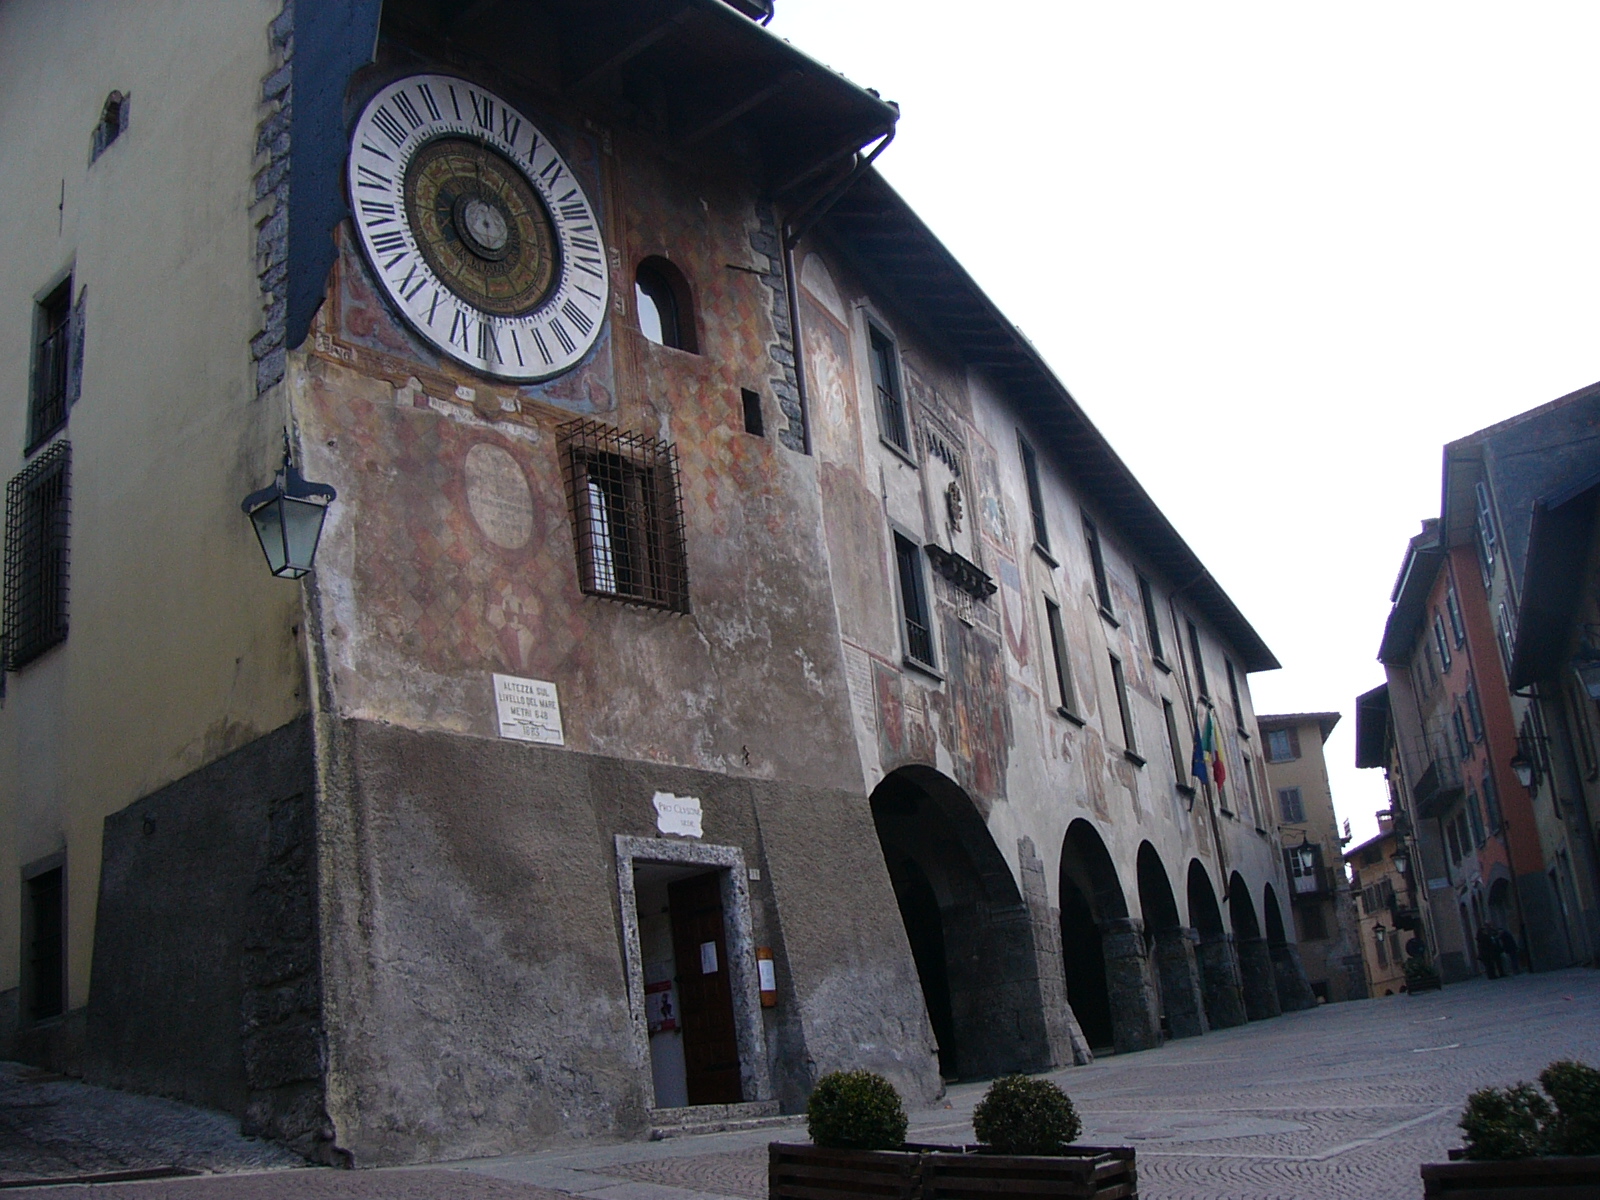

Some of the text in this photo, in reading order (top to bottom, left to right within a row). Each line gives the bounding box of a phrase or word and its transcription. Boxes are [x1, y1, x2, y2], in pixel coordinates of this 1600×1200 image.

[391, 90, 424, 130] III
[418, 84, 442, 121] II
[449, 85, 461, 121] I
[469, 90, 494, 132] XII
[371, 104, 408, 149] IIII
[498, 107, 521, 147] XI
[362, 132, 395, 163] V
[522, 133, 546, 165] X
[358, 165, 392, 192] VI
[539, 157, 569, 190] IX
[360, 199, 396, 228] VII
[557, 188, 590, 221] VIII
[370, 230, 409, 271] VIII
[569, 224, 599, 253] VII
[391, 262, 428, 303] IX
[573, 255, 603, 280] VI
[418, 289, 449, 328] X
[573, 284, 601, 310] V
[448, 308, 475, 354] XI
[548, 317, 577, 356] III
[561, 298, 595, 338] IIII
[477, 321, 504, 365] XII
[511, 328, 525, 367] I
[530, 327, 554, 365] II
[499, 694, 556, 709] LIVELLO DEL MARE
[504, 682, 549, 697] ALTEZZA SUL
[511, 707, 532, 717] METRI
